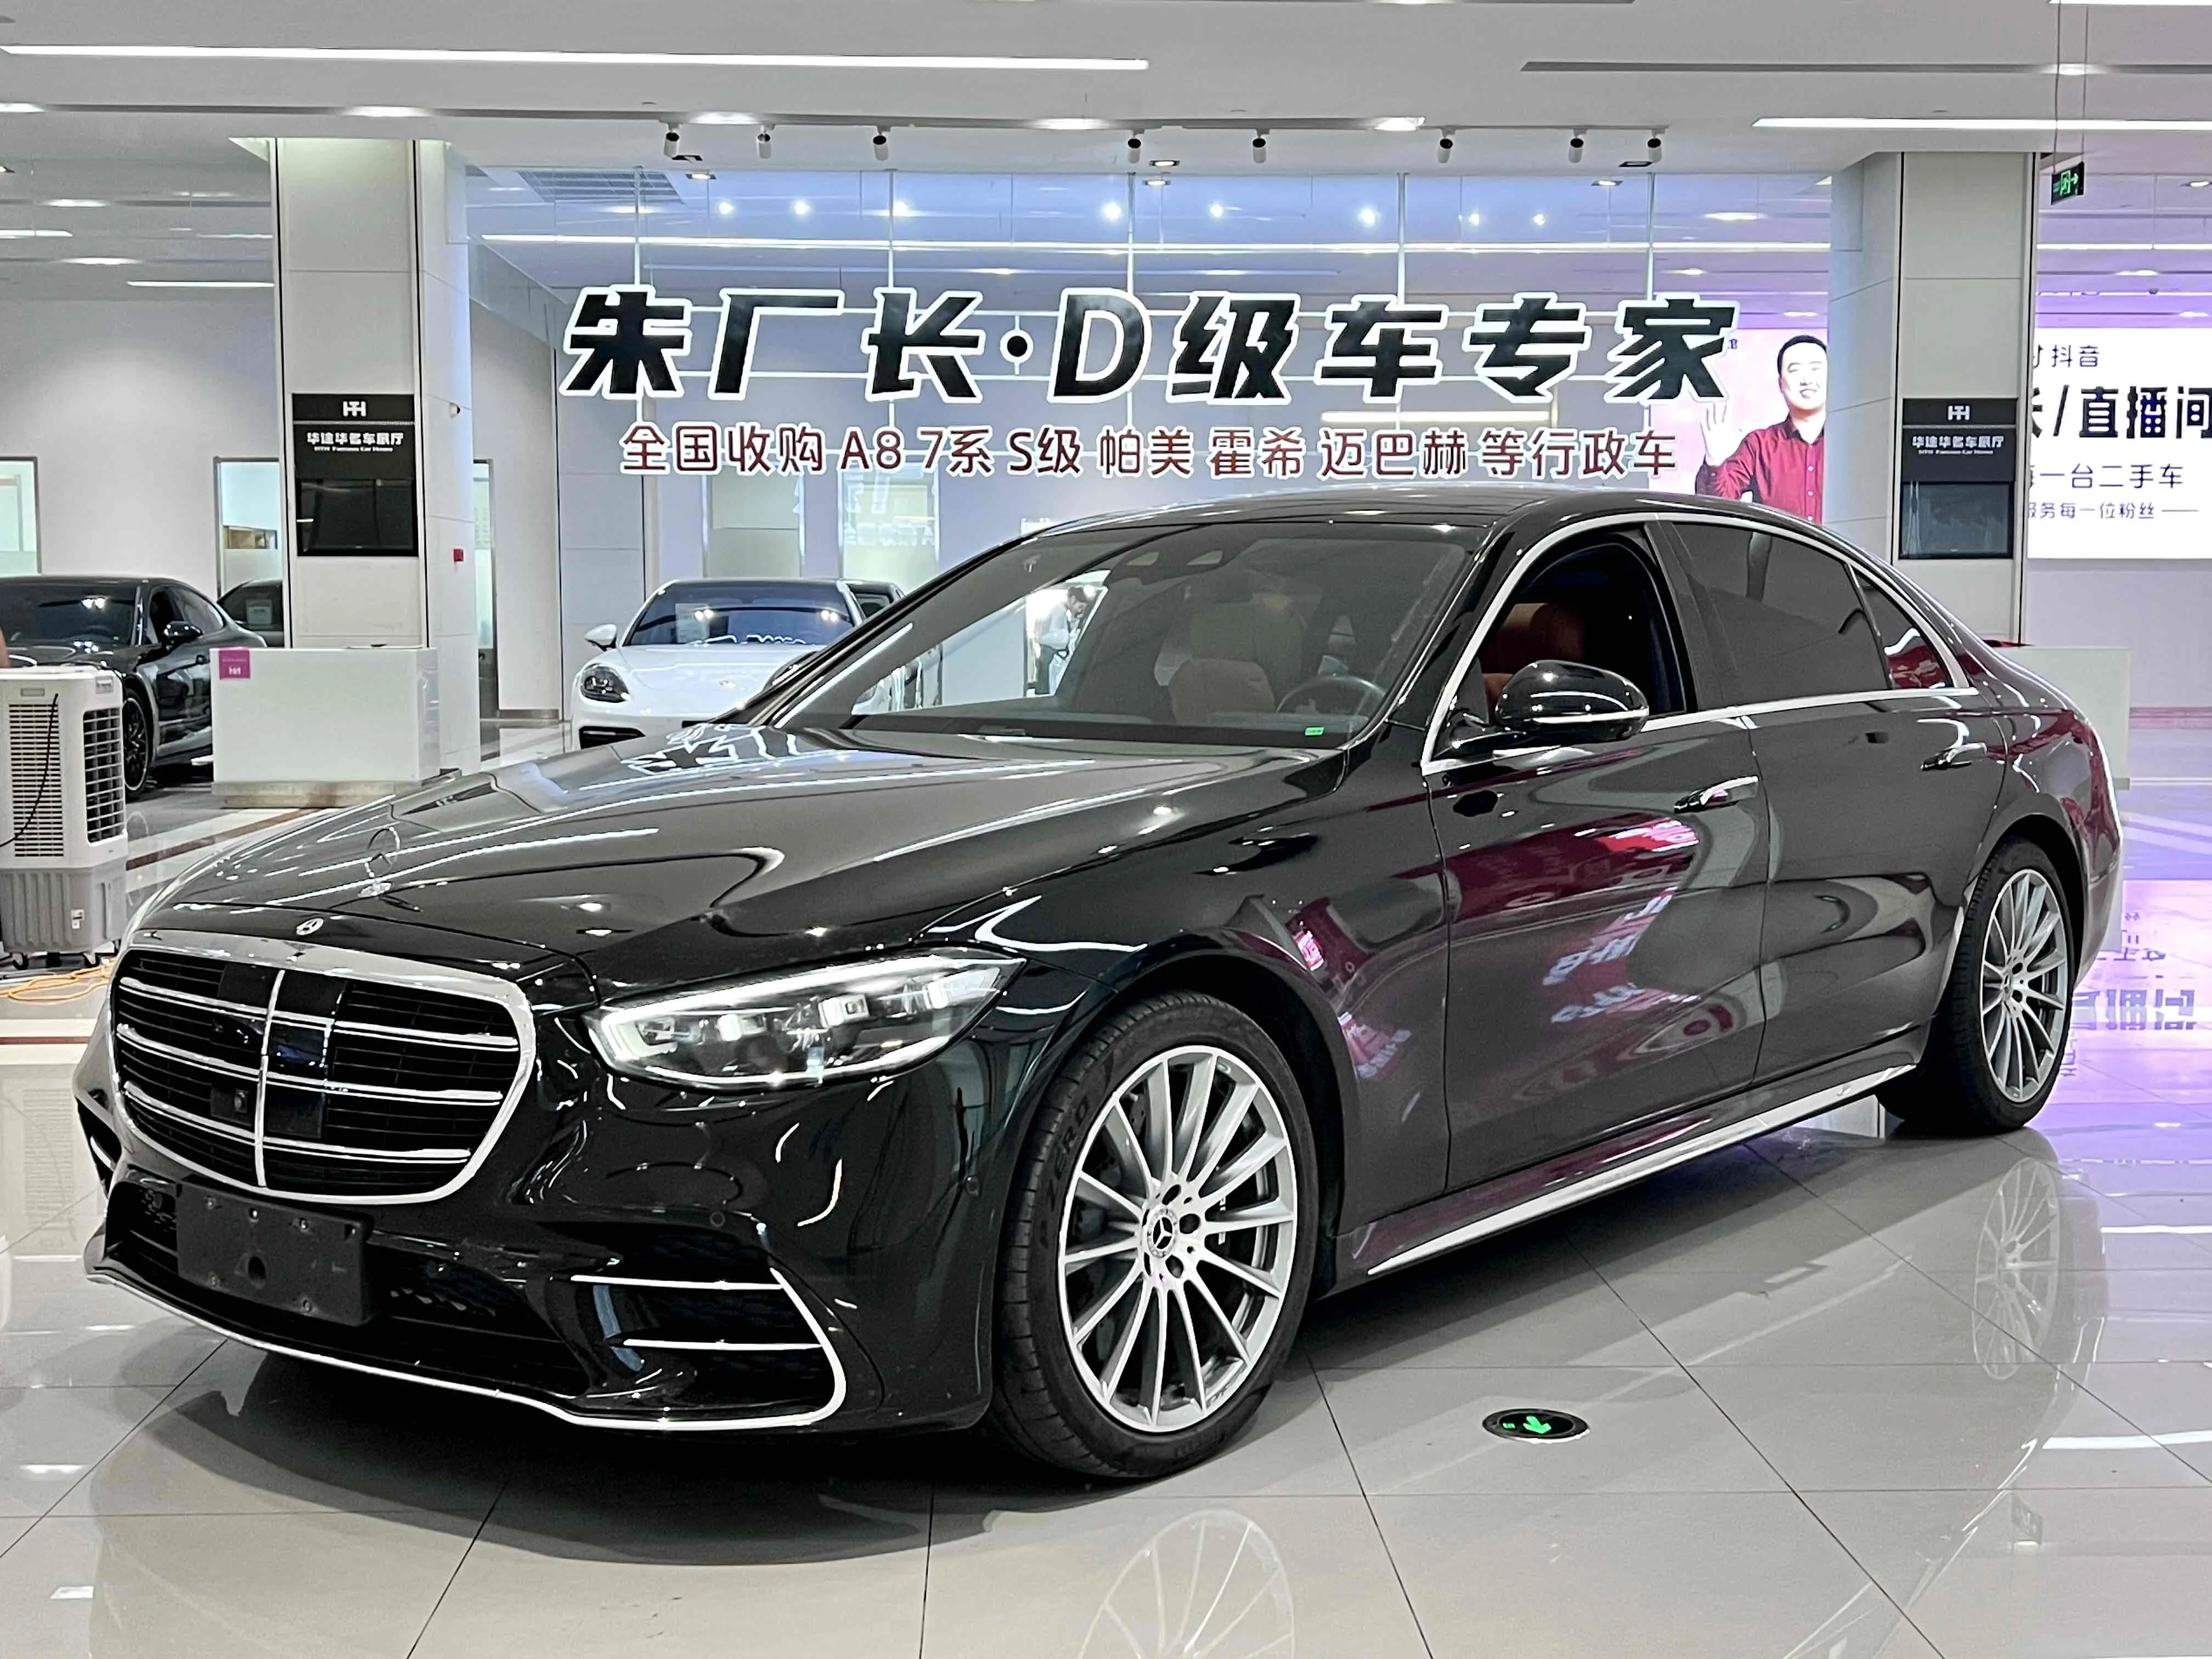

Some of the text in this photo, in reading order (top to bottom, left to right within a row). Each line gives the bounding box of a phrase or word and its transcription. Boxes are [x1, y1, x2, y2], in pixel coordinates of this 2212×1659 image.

[2051, 345, 2099, 368] 抖音
[622, 425, 1677, 477] 全国收购 A8 7系 S级 帕美 霍希 迈巴赫 等行政车
[2030, 463, 2183, 489] 一台二手车
